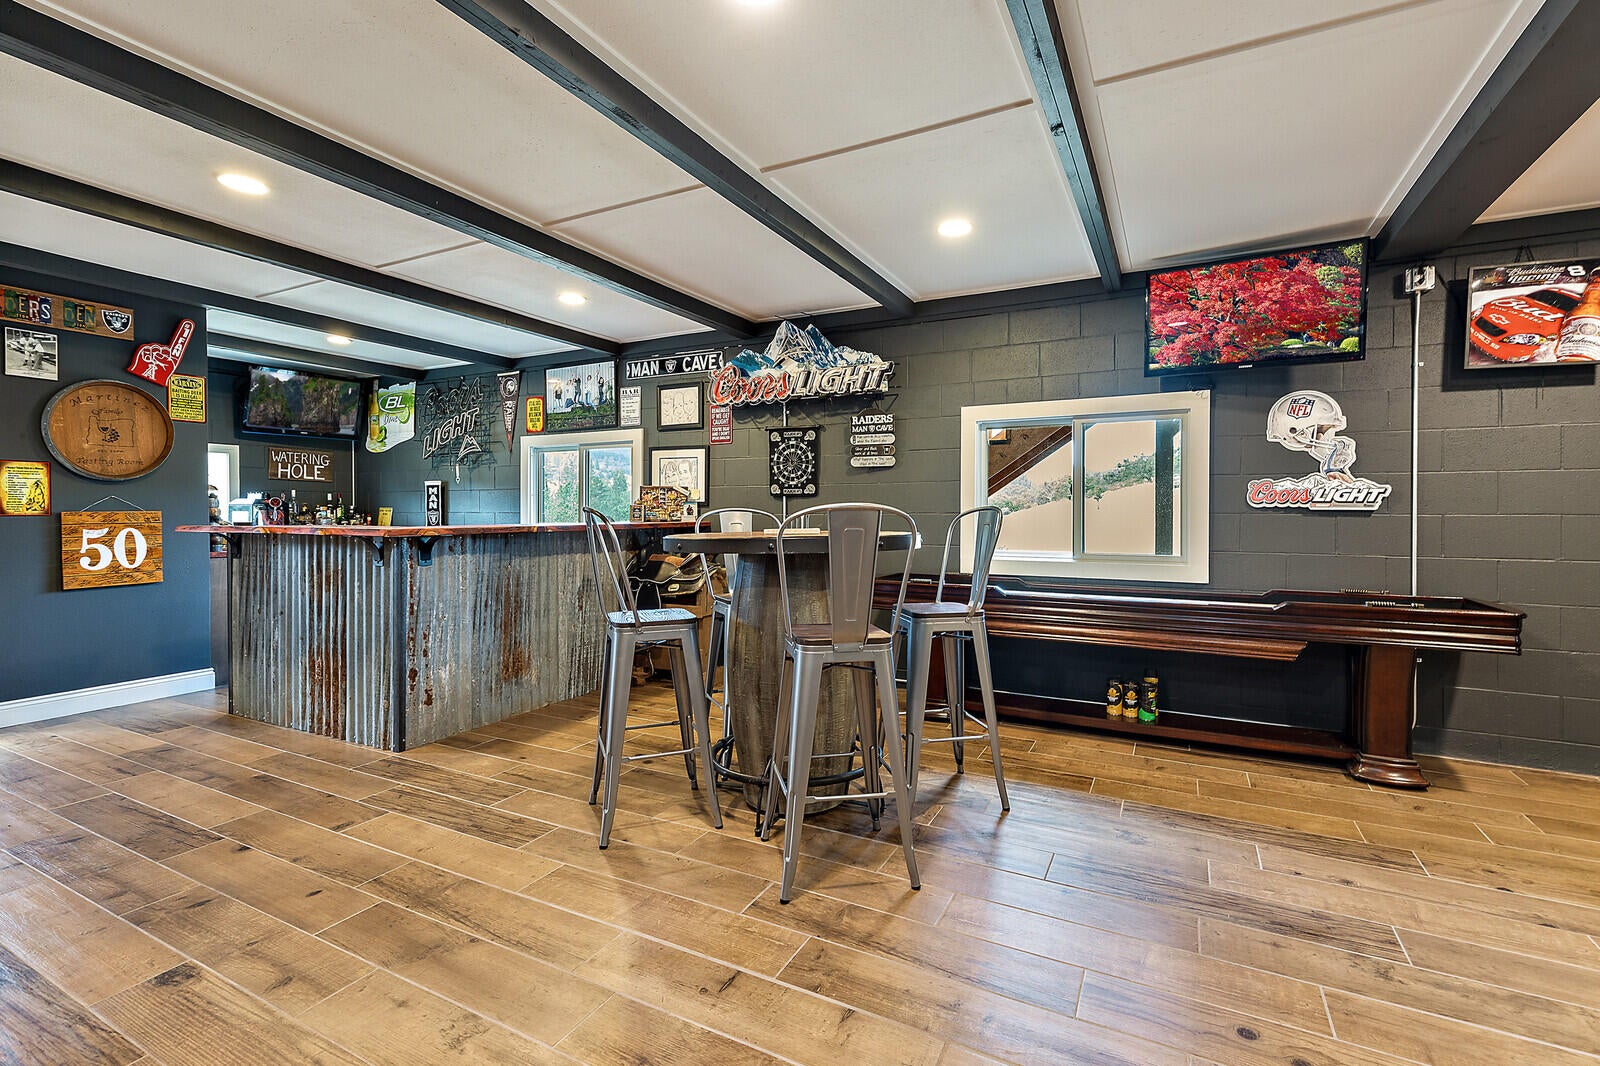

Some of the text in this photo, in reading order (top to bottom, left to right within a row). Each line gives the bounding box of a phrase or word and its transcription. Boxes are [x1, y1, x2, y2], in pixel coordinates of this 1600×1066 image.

[1506, 266, 1566, 278] Budweiser
[1567, 265, 1587, 277] 8
[1508, 273, 1561, 285] Racing
[0, 296, 51, 319] DERS
[1491, 299, 1565, 321] Bud
[171, 337, 186, 357] FAN
[630, 354, 717, 378] MAN CAVE
[707, 361, 895, 406] Coors LIGHT
[385, 396, 406, 409] BL
[1289, 404, 1310, 417] NFL
[851, 414, 894, 425] RAIDERS
[851, 424, 894, 433] MAN CAVE
[422, 407, 480, 459] LIGHT
[271, 450, 331, 466] WATERING
[278, 462, 325, 480] HOLE
[428, 486, 438, 509] MAN
[1250, 481, 1386, 504] Coors LIGHT
[79, 527, 148, 571] 50
